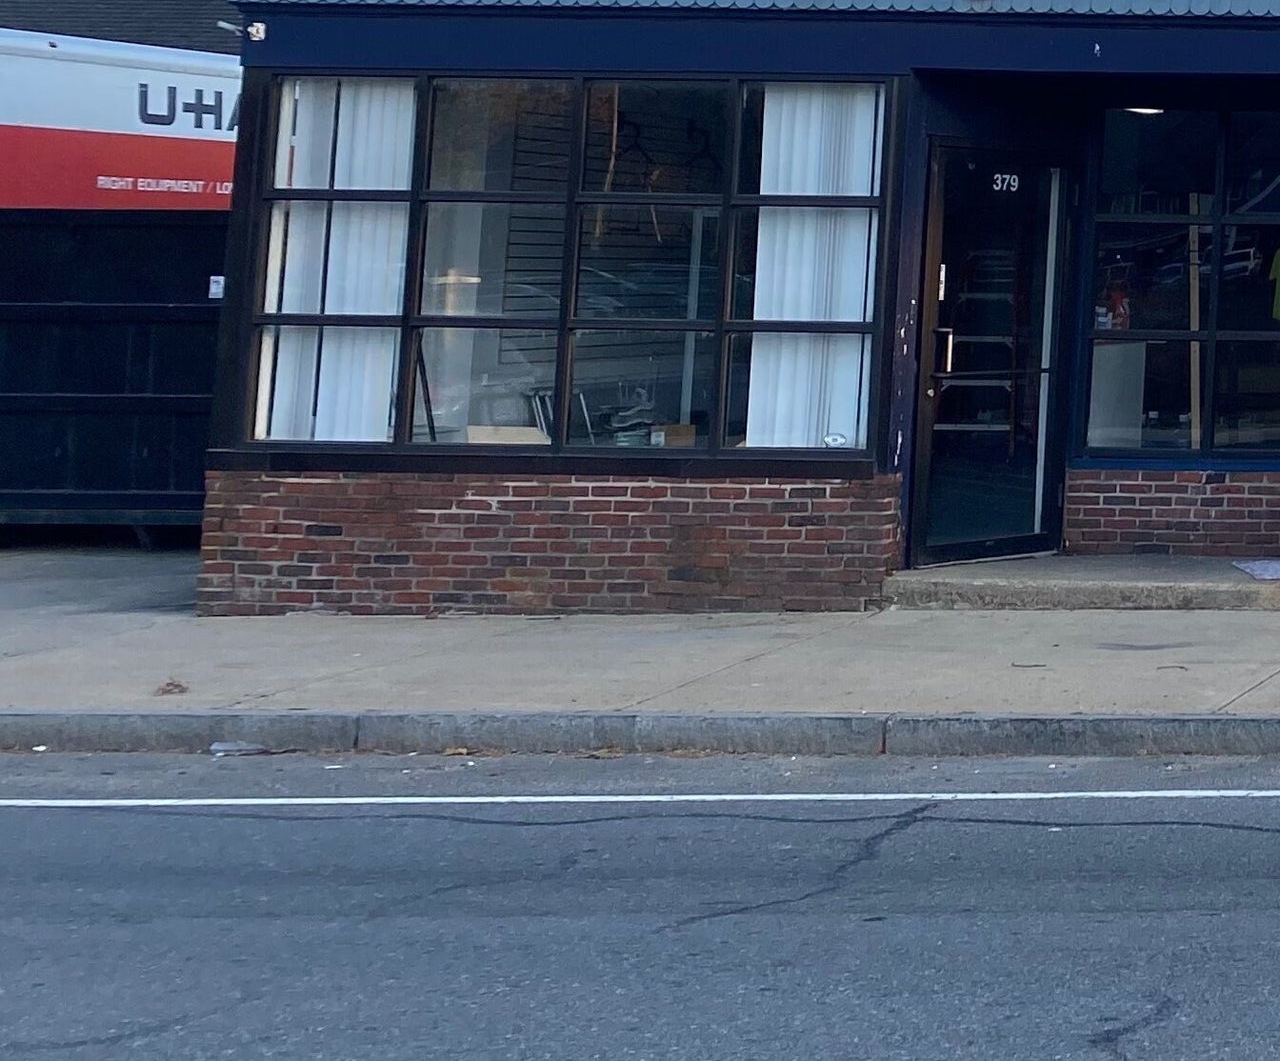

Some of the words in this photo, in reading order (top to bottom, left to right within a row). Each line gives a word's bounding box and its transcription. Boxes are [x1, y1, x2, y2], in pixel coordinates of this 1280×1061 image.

[137, 178, 205, 193] EQUIPMENT
[216, 181, 233, 194] LO
[993, 173, 1019, 192] 379
